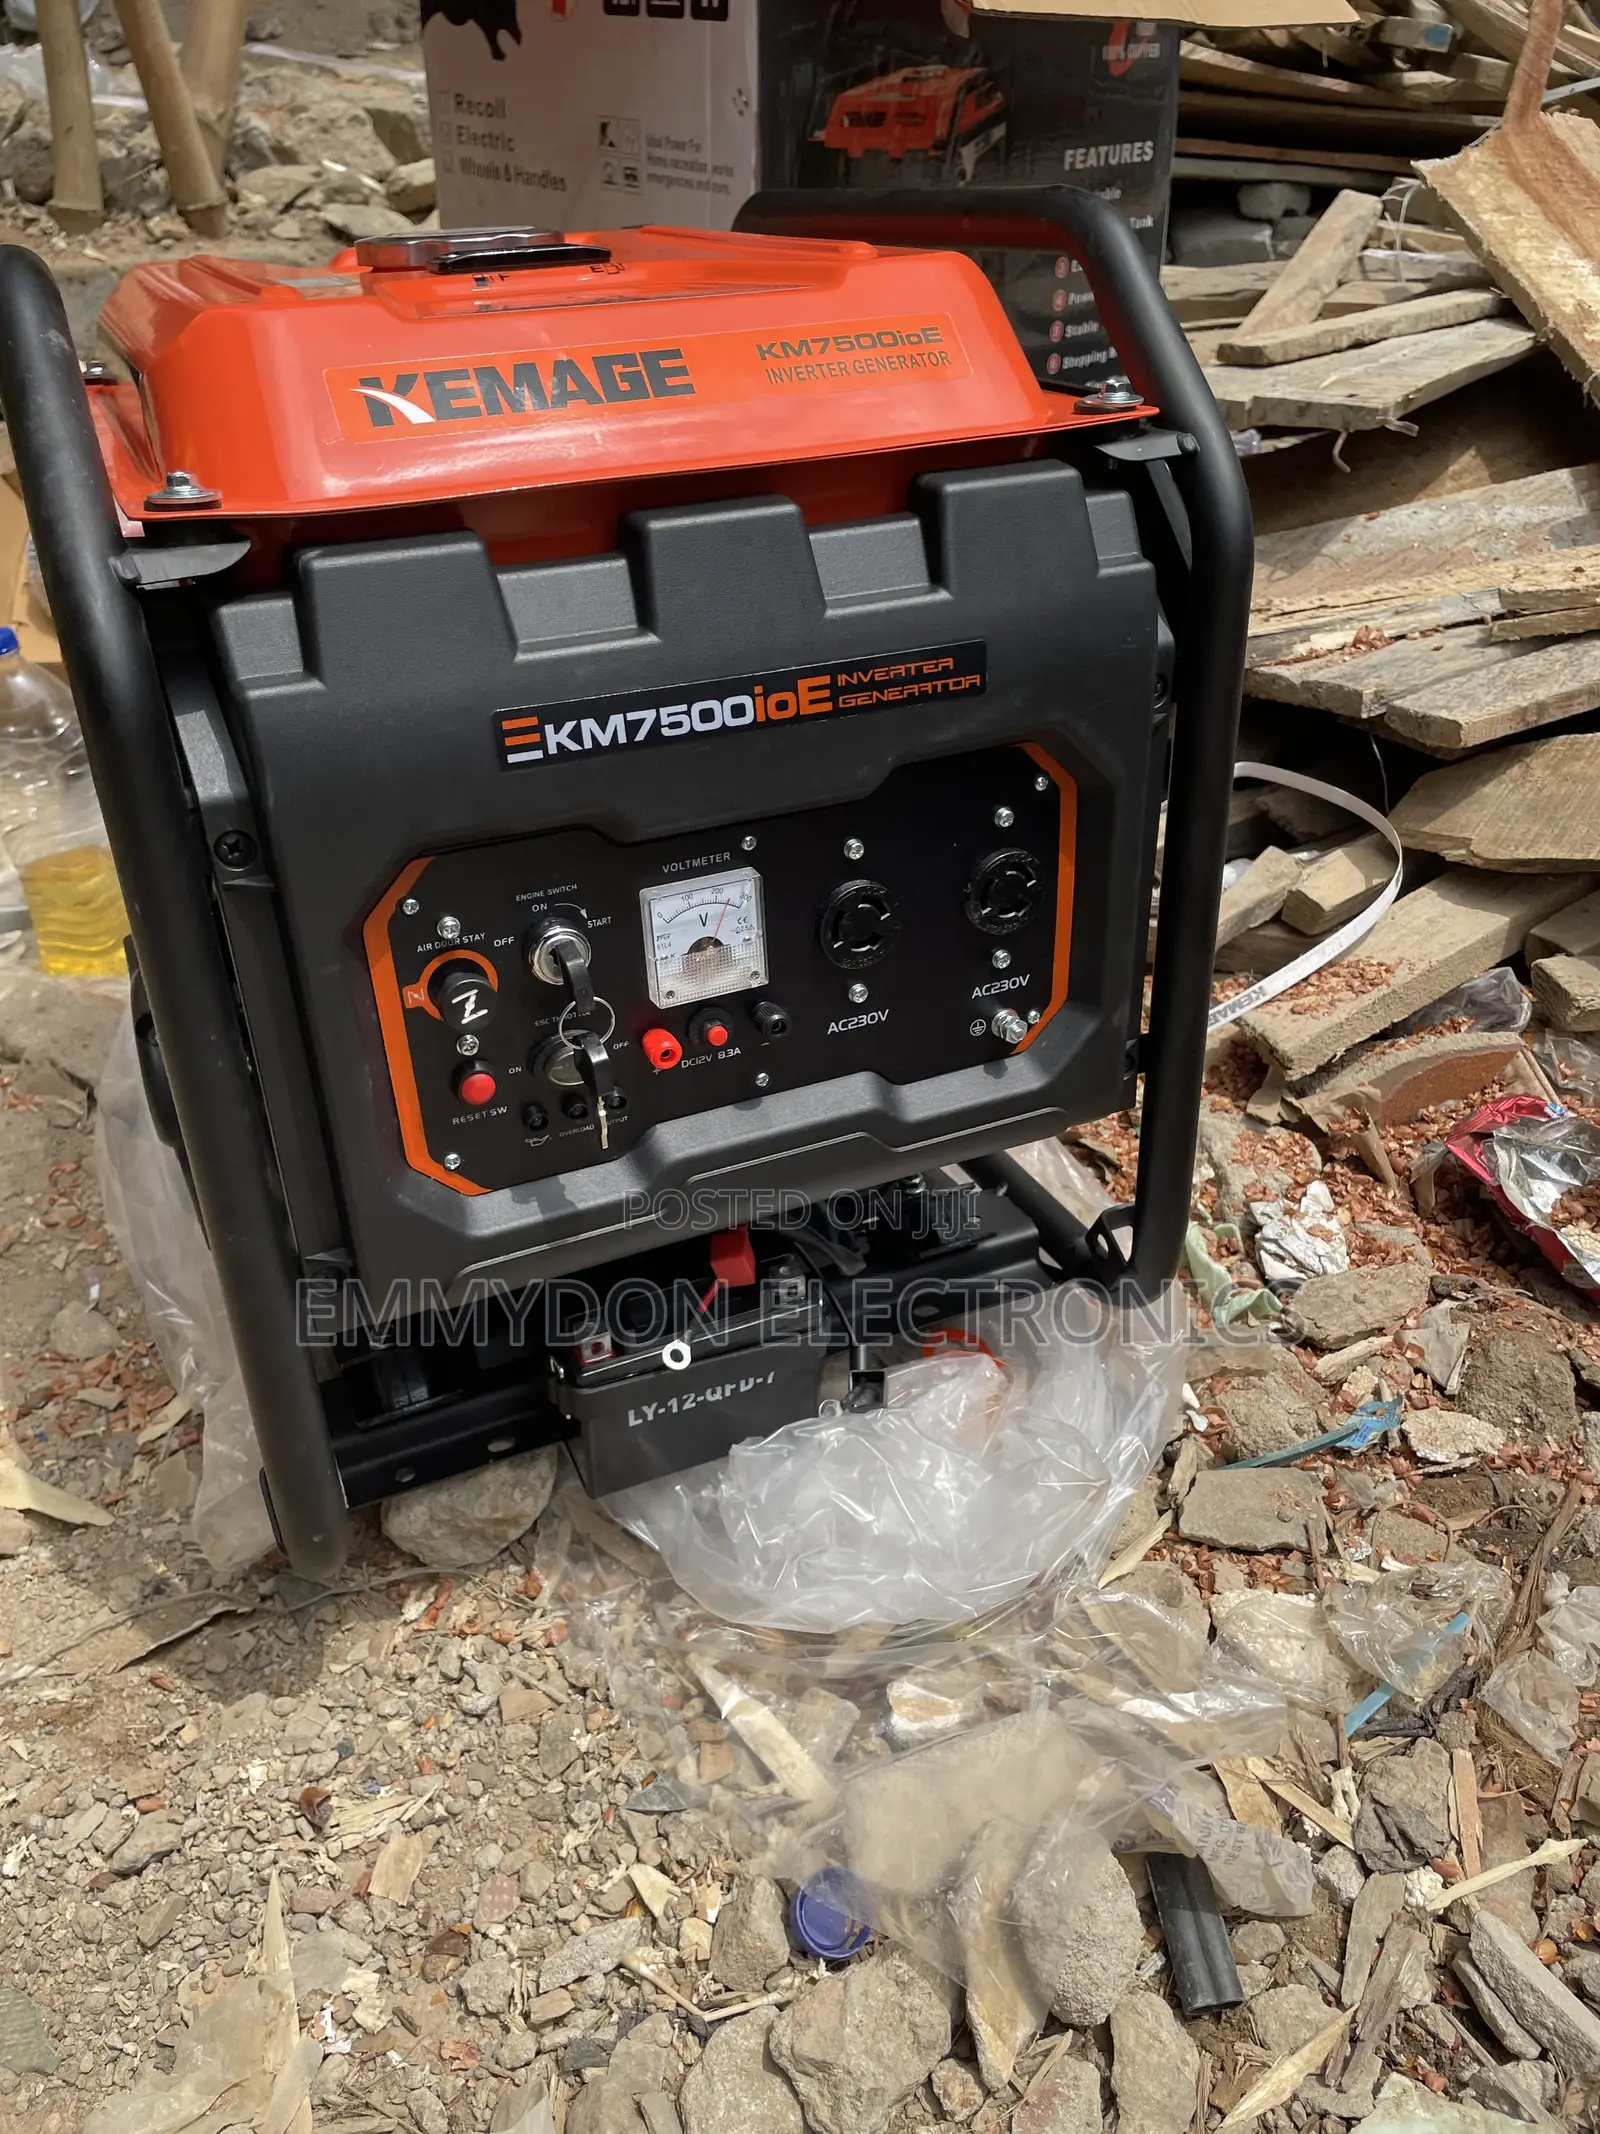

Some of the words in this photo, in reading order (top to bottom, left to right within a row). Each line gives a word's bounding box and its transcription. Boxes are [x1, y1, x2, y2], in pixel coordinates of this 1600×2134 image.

[454, 93, 506, 119] Recoil
[457, 125, 515, 152] Electric
[1064, 141, 1155, 171] FEATURES
[589, 264, 604, 274] E
[756, 326, 944, 361] KM7500ioE
[765, 360, 850, 386] INVERTER
[852, 350, 952, 375] GENERATOR
[350, 348, 696, 427] KEMAGE
[837, 657, 955, 687] INVERTER
[838, 673, 980, 708] GENERATOR
[662, 852, 731, 873] VOLTMETER
[516, 890, 545, 902] ENGINE
[547, 884, 578, 895] SWITCH
[681, 893, 694, 902] 100
[711, 887, 724, 895] 200
[532, 903, 548, 912] ON
[587, 916, 612, 928] START
[699, 913, 709, 927] V
[417, 943, 433, 953] AIR
[434, 937, 461, 949] DOOR
[462, 932, 486, 943] STAY
[494, 936, 515, 947] OFF
[972, 974, 1030, 999] AC230V
[827, 1009, 889, 1035] AC230V
[613, 1040, 630, 1050] OFF
[508, 1066, 522, 1075] ON
[681, 1054, 713, 1069] DC12V
[452, 1110, 488, 1125] RESET
[489, 1105, 508, 1117] SW
[607, 1115, 629, 1126] UTPUT
[559, 1124, 595, 1137] OVERLOAD
